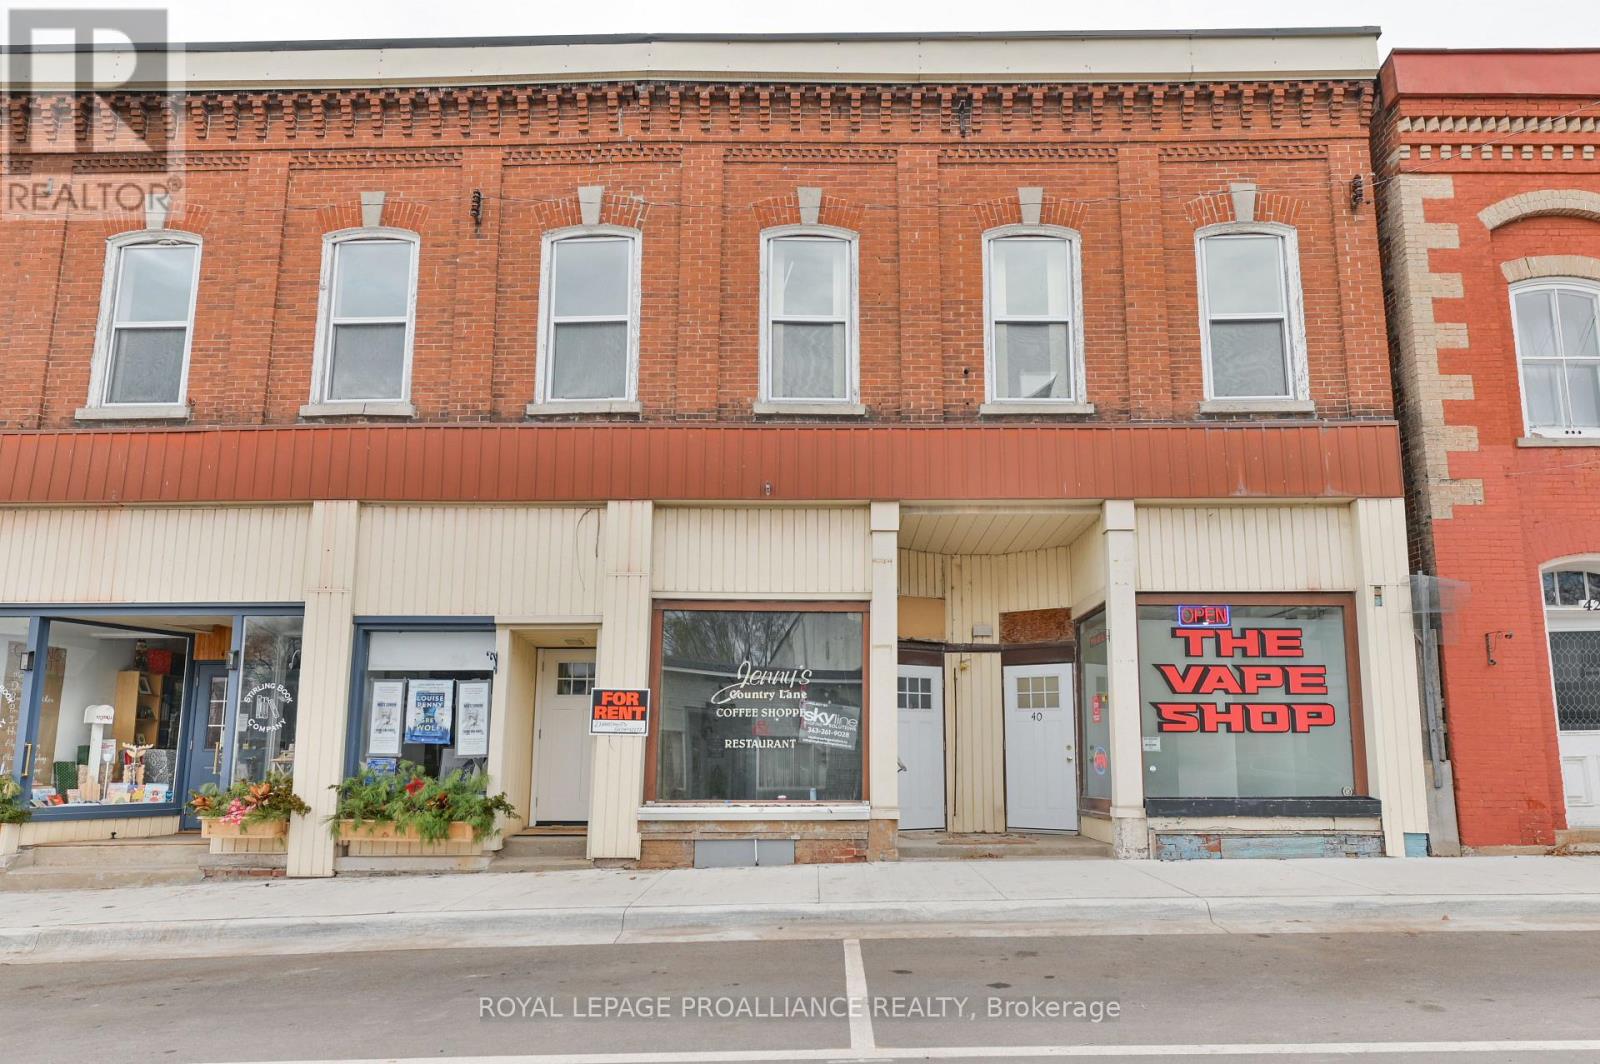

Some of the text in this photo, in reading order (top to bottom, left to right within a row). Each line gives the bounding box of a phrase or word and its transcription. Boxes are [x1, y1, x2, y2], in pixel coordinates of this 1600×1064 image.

[1181, 607, 1228, 623] OPEN
[1171, 627, 1304, 657] THE
[711, 660, 813, 704] Jenny's
[1152, 664, 1328, 695] VAPE
[244, 683, 293, 703] STIRLING BOOK
[602, 691, 640, 706] FOR
[730, 690, 808, 701] Country Lane
[594, 705, 646, 720] RENT
[716, 708, 758, 718] COFFEE
[1031, 712, 1043, 721] 40
[1149, 702, 1336, 733] SHOP
[248, 718, 287, 732] COMPANY
[724, 739, 797, 749] RESTAURANT
